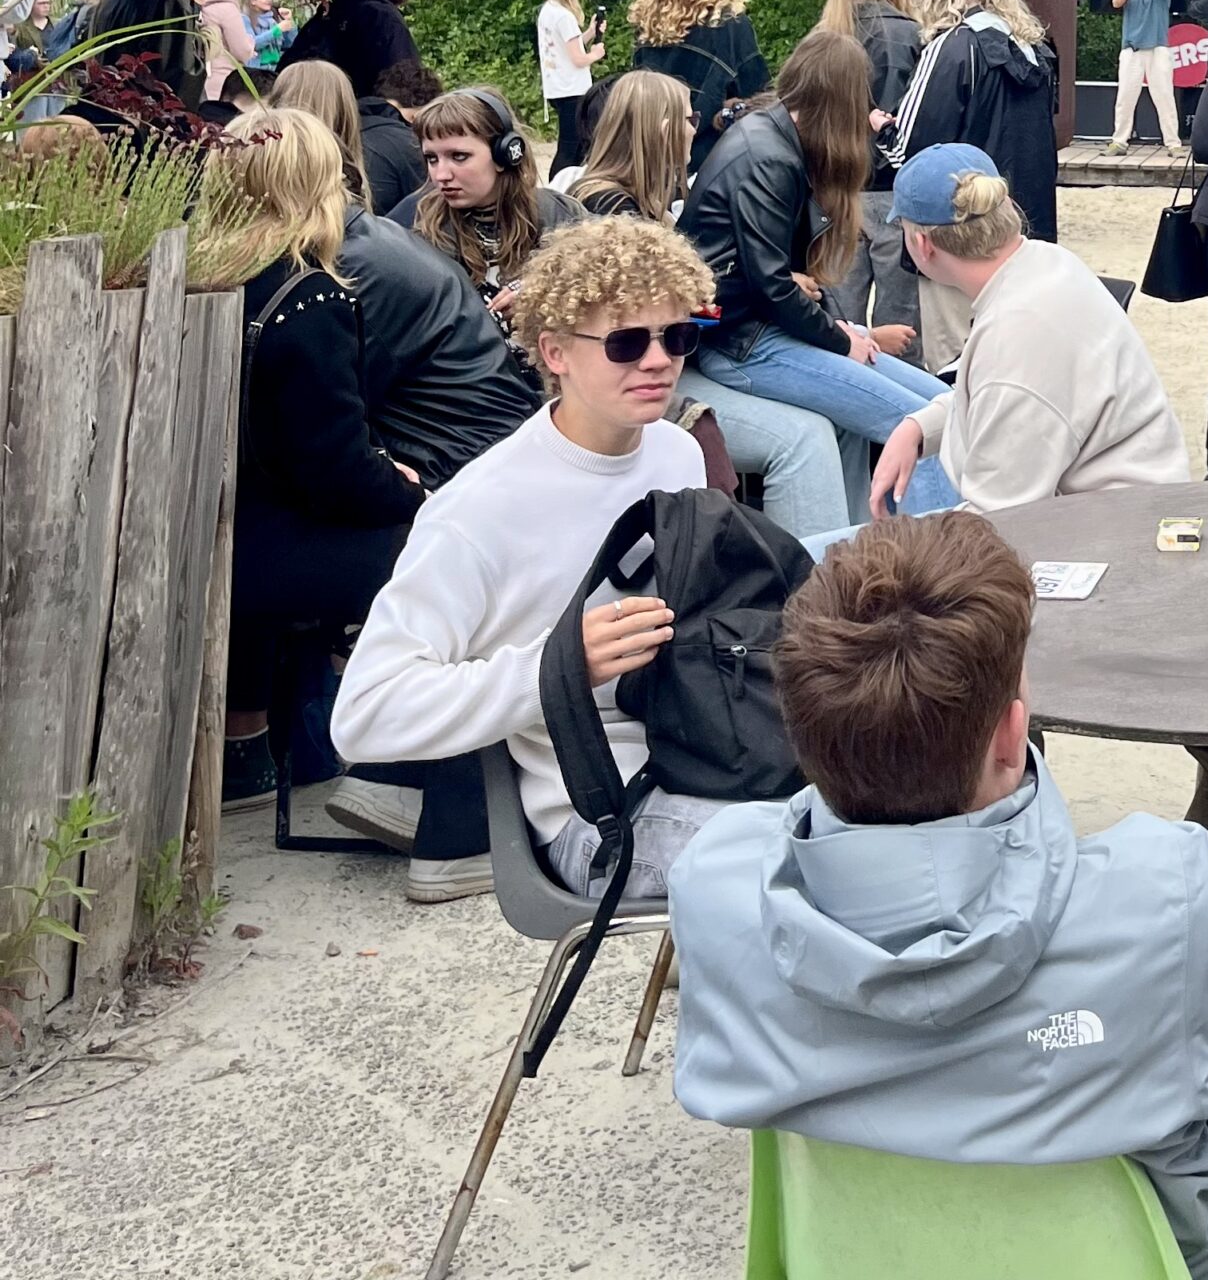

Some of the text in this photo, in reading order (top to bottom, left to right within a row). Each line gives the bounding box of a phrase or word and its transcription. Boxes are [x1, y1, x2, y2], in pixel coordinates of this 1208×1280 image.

[1048, 1010, 1077, 1027] THE
[1027, 1021, 1077, 1043] NORTH
[1042, 1033, 1078, 1052] FACE
